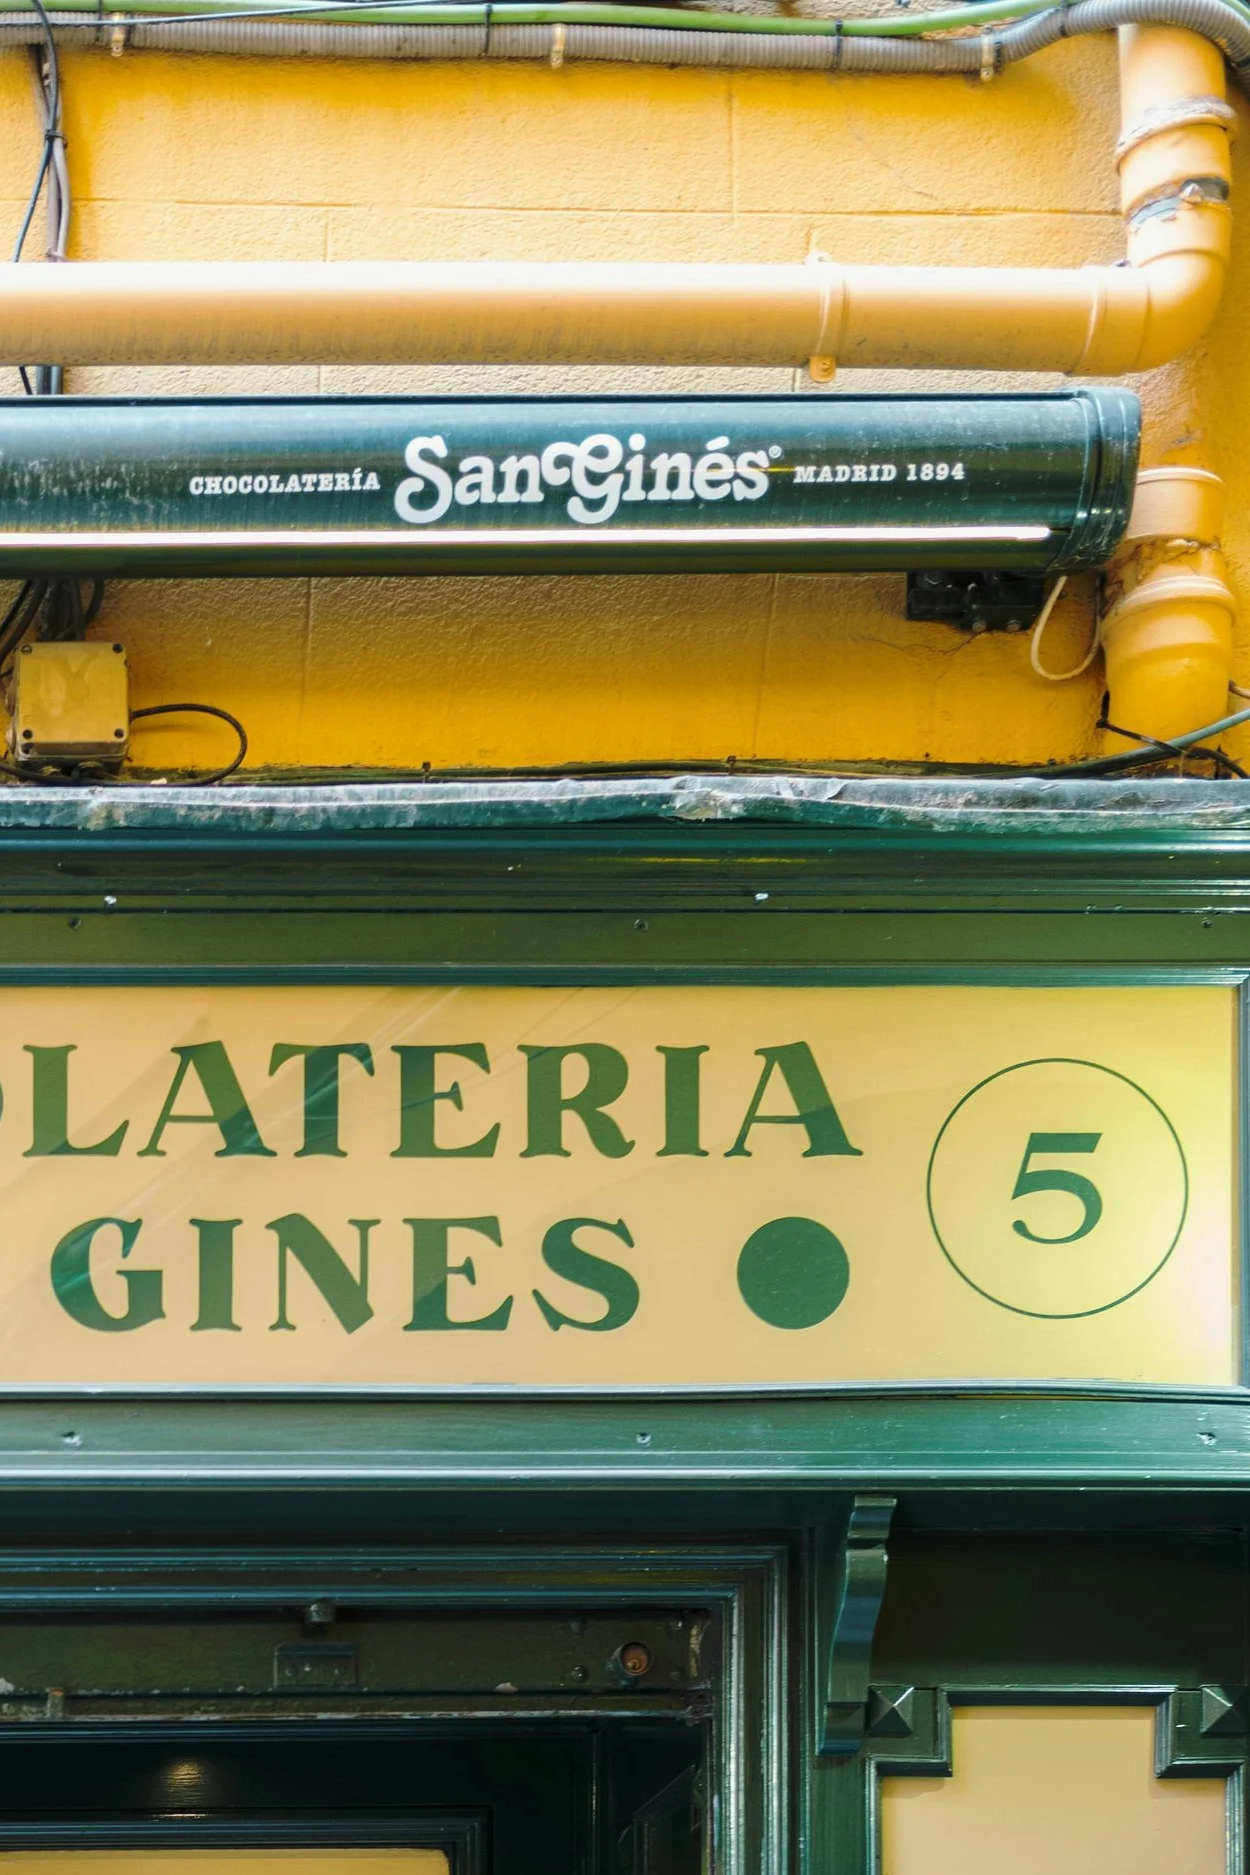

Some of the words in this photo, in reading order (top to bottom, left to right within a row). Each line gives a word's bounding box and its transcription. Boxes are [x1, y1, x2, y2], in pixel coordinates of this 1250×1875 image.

[189, 467, 381, 495] CHOCOLATERÍA
[793, 464, 897, 483] MADRID
[906, 462, 966, 481] 1894
[1010, 1132, 1104, 1245] 5
[50, 1213, 641, 1335] GINES
